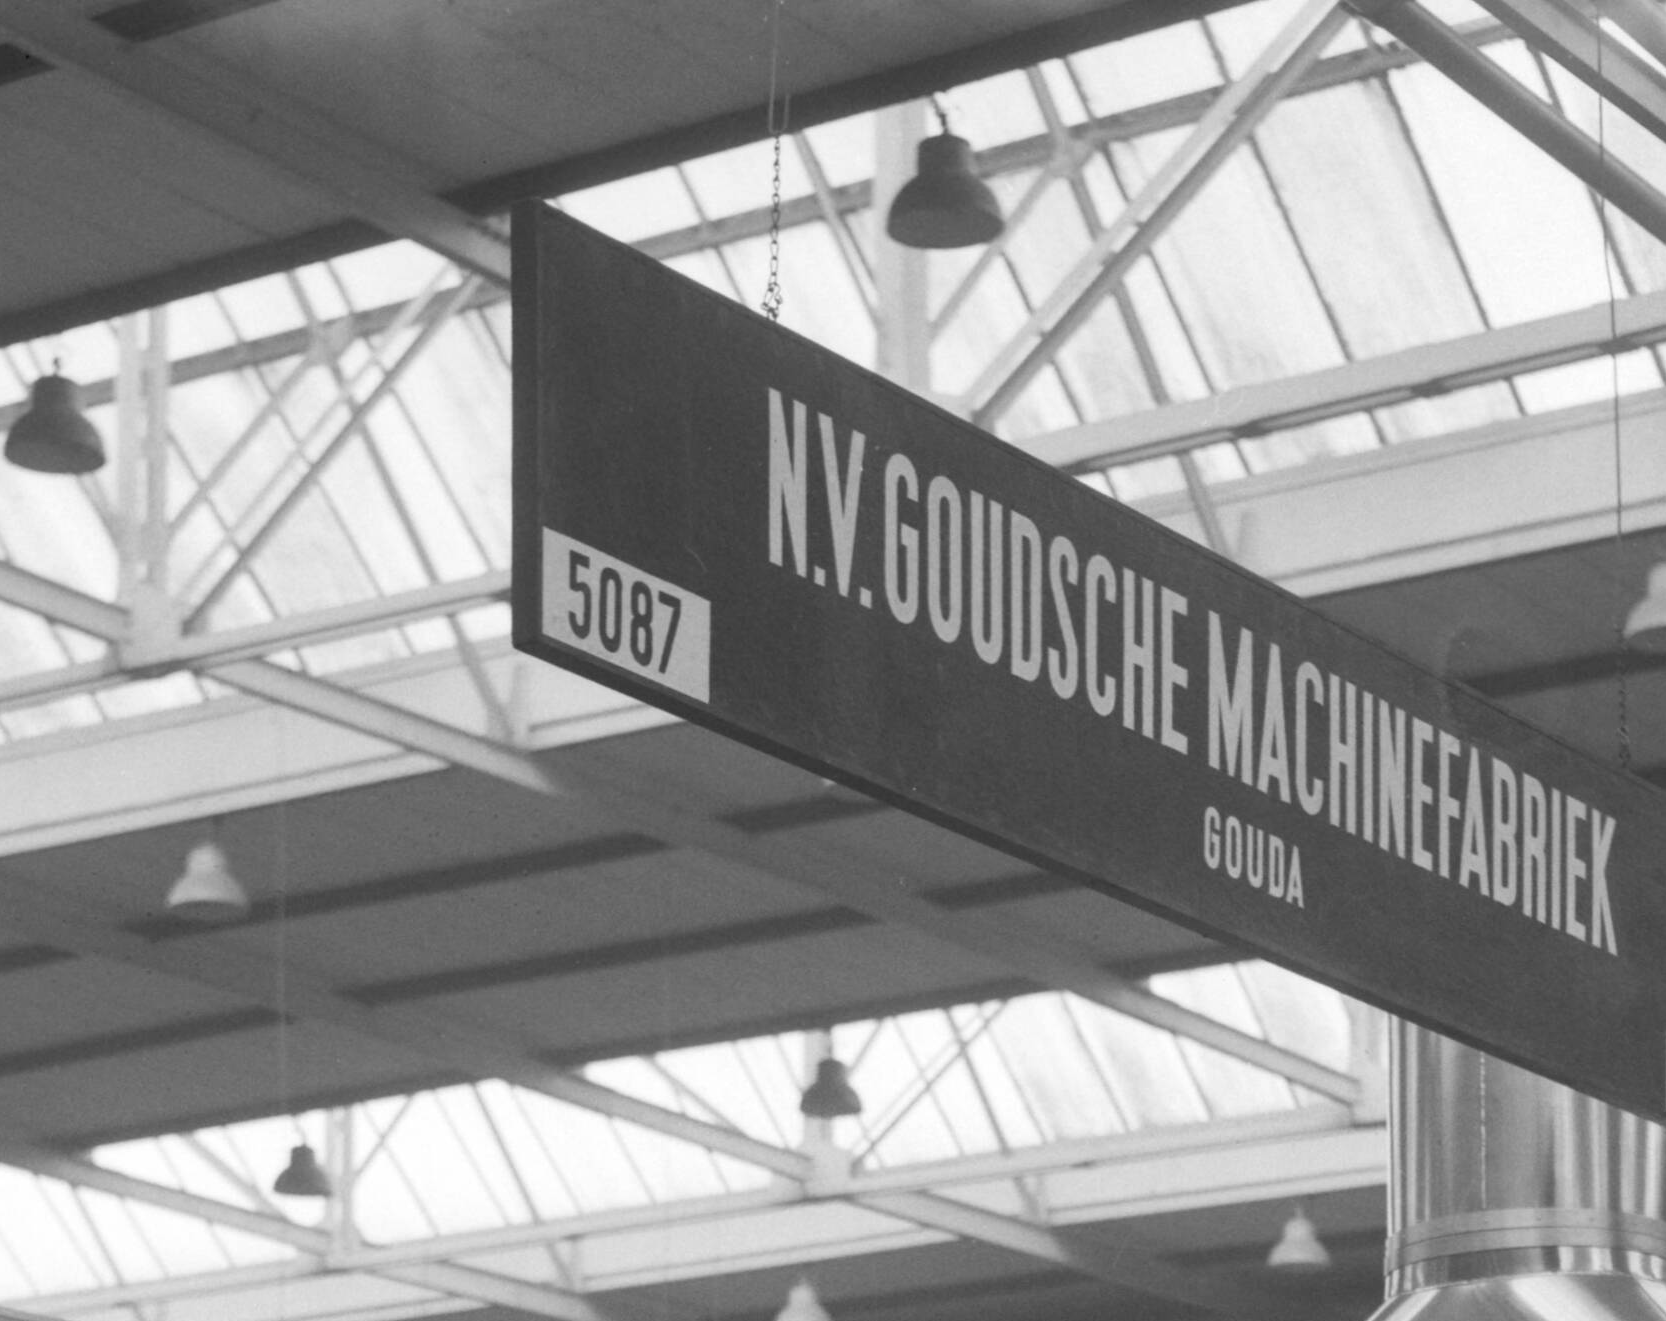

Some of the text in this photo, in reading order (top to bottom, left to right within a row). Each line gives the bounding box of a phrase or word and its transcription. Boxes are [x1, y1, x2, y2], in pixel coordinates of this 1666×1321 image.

[569, 549, 681, 675] 5087
[768, 387, 1618, 956] N.V. GOUDSCHE MACHINEFABRIEK
[1203, 806, 1304, 909] GOUDA
